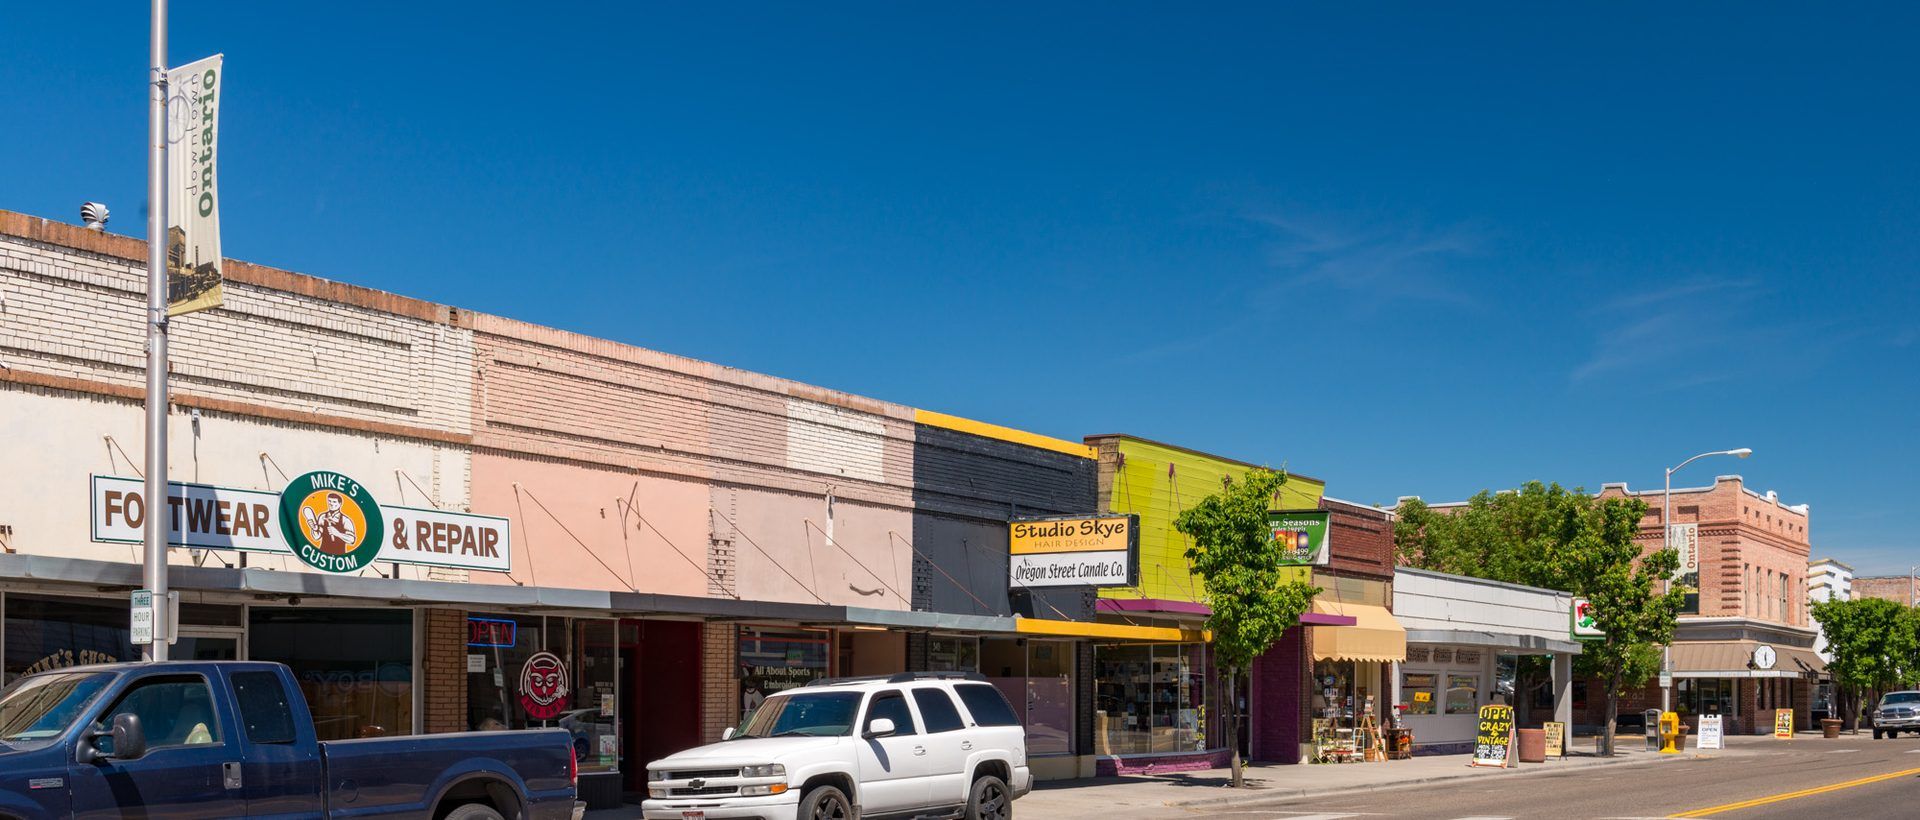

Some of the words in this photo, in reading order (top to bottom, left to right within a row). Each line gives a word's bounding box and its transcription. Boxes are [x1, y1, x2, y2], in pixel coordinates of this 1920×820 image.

[186, 73, 198, 196] downtown
[198, 69, 217, 218] Ontario
[310, 473, 360, 497] MIKE'S
[105, 490, 270, 538] FOTWEAR
[1015, 522, 1075, 538] Studio
[1080, 520, 1125, 538] Skye
[1282, 518, 1320, 527] Seasons
[392, 517, 410, 550] &
[416, 520, 500, 558] REPAIR
[1034, 540, 1061, 549] HAIR
[1065, 538, 1104, 547] DESIGN
[1687, 527, 1696, 569] Ontario
[301, 544, 358, 571] CUSTOM
[1016, 564, 1046, 581] Oregon
[1048, 563, 1076, 578] Street
[1078, 562, 1108, 577] Candle
[1111, 561, 1124, 577] Co.
[134, 596, 150, 606] THREE
[133, 611, 150, 622] HOUR
[132, 626, 150, 637] PARKING
[754, 665, 764, 676] All
[766, 665, 787, 676] About
[788, 666, 811, 678] Sports
[764, 680, 801, 690] Embroidery
[1480, 706, 1513, 720] OPEN
[1480, 722, 1512, 731] CRAZY
[1477, 736, 1508, 746] VINTAGE
